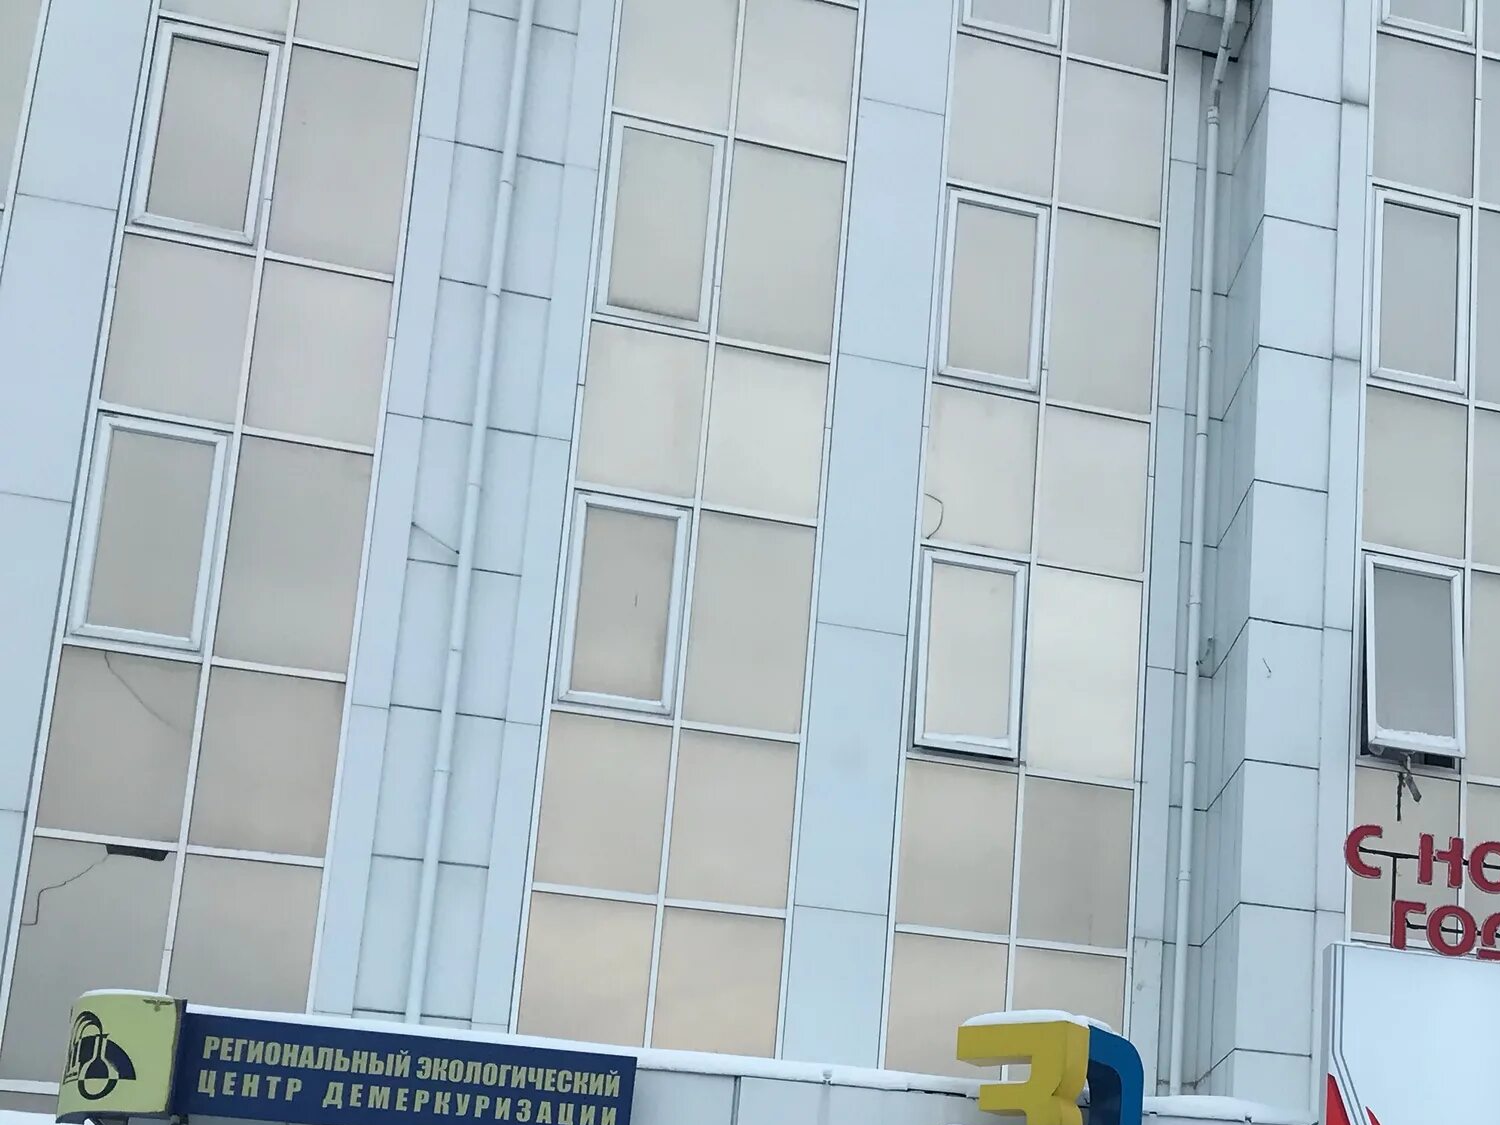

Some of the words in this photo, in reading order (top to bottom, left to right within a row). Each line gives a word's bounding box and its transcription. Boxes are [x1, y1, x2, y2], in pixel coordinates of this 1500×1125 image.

[1344, 824, 1383, 879] С
[197, 1069, 304, 1102] ЦЕНТР
[202, 1035, 412, 1079] РЕГИОНАЛЬНЫЙ
[416, 1056, 621, 1098] ЭКОЛОГИЧЕСКИЙ
